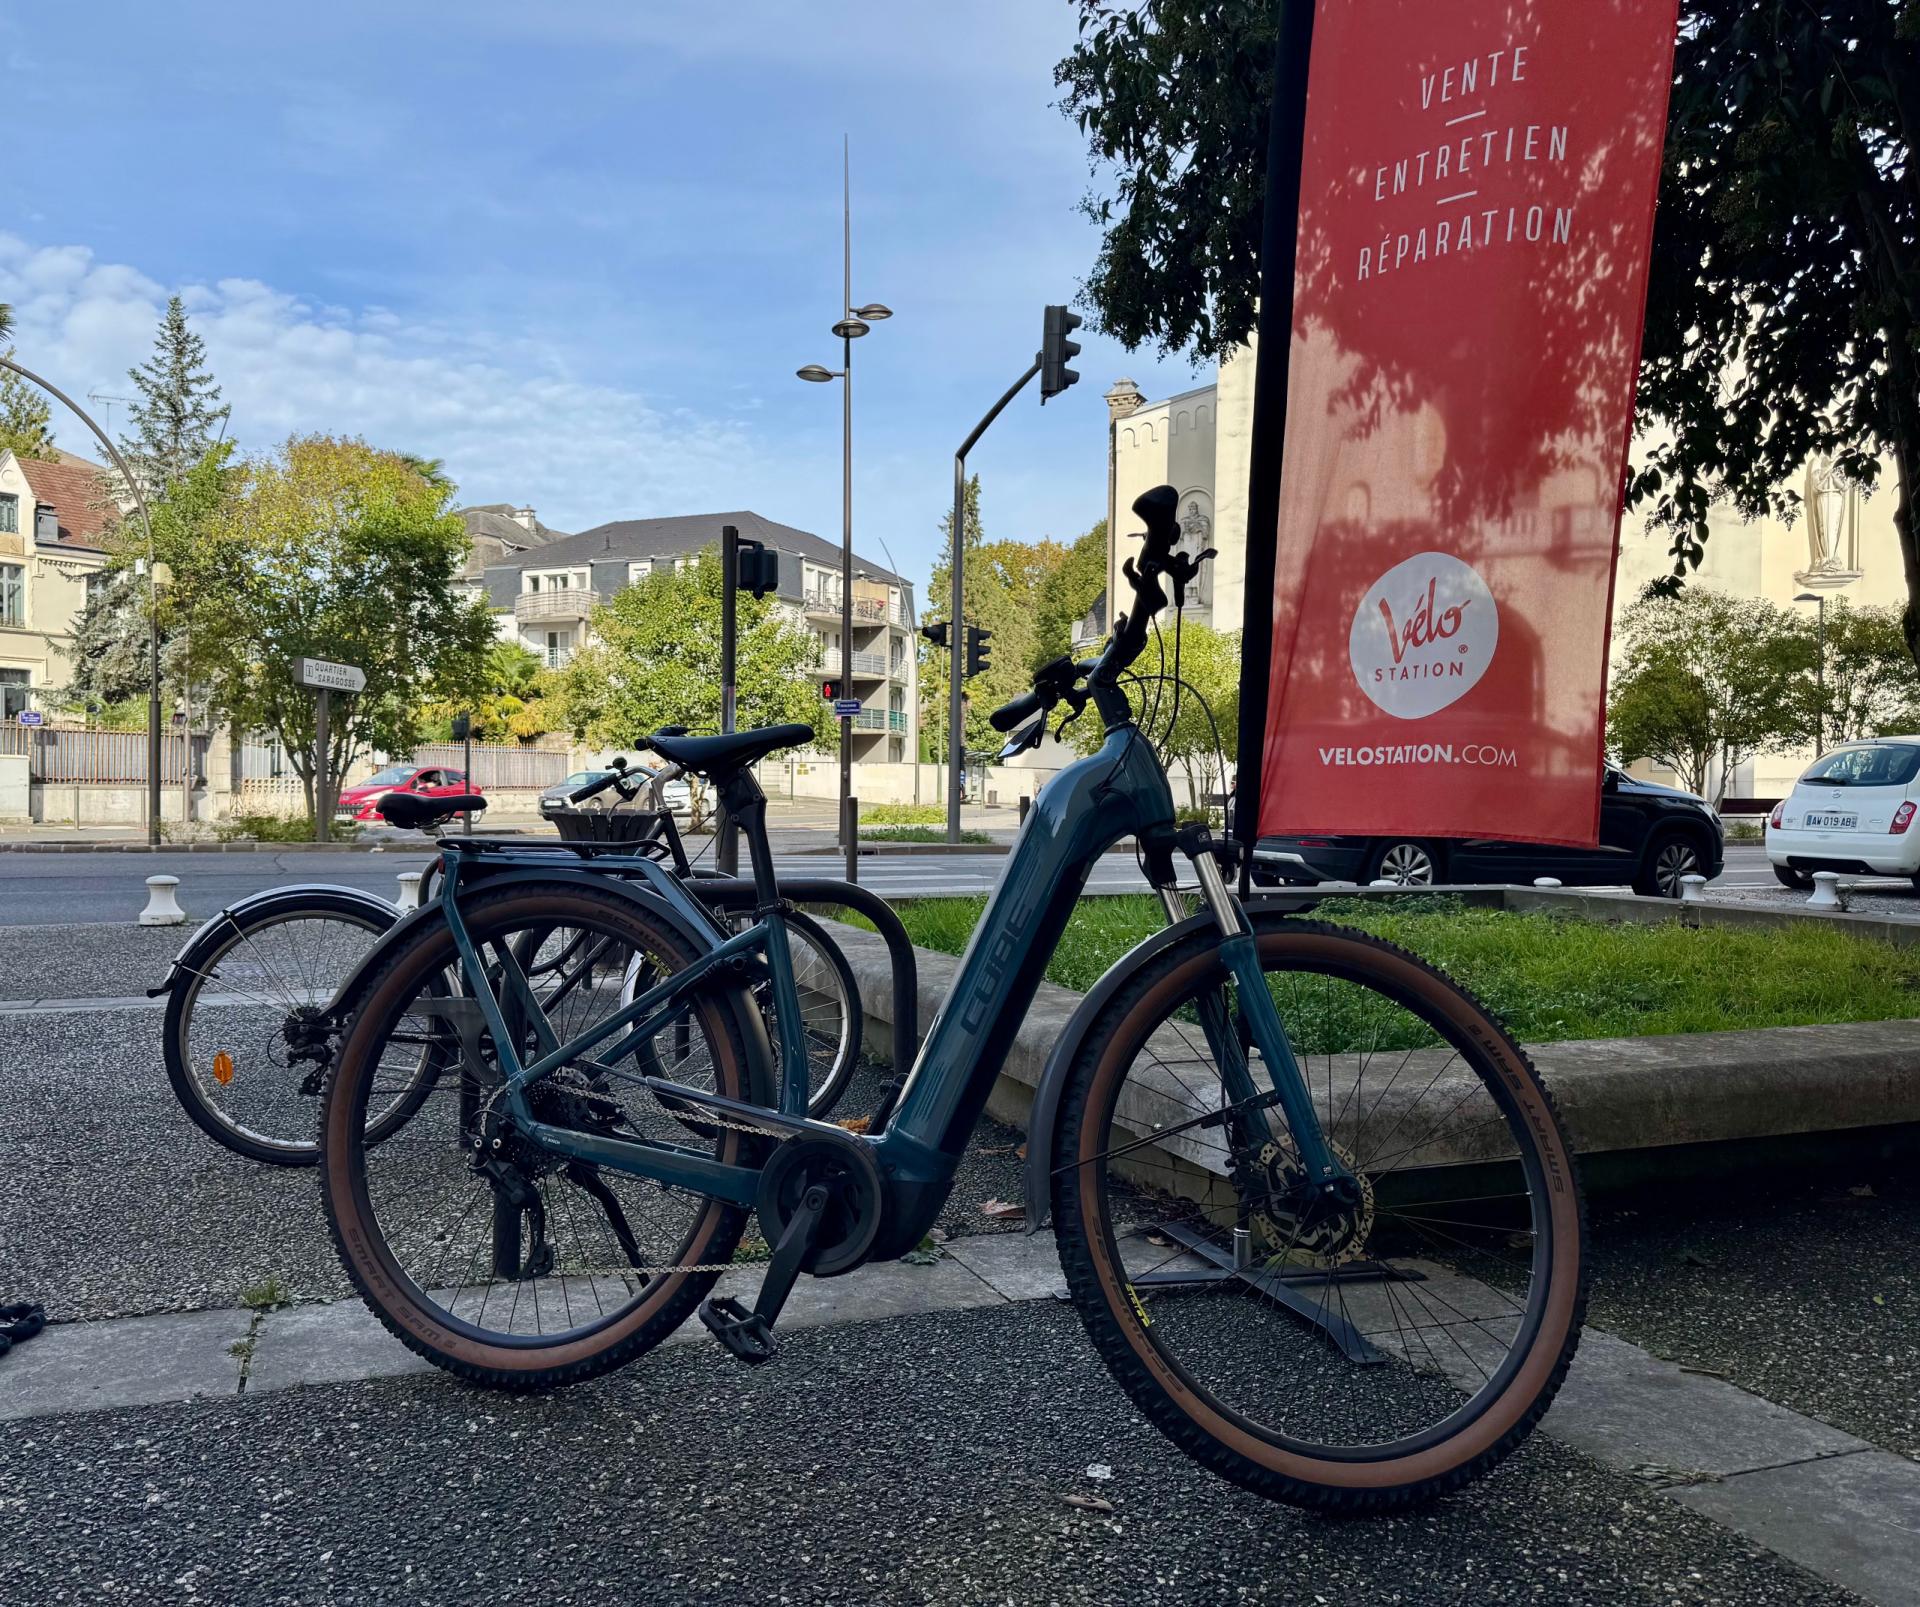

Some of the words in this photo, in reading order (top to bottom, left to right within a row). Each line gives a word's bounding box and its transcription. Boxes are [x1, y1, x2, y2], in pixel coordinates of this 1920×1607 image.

[1421, 46, 1528, 110] VENTE
[1374, 125, 1568, 201] ENTRETIEN
[1357, 205, 1572, 281] RÉPARATION
[1378, 576, 1471, 664] Vélo
[314, 662, 348, 676] QUARTIER
[317, 674, 356, 688] SARAGOSSE
[1375, 661, 1464, 682] STATION
[1318, 744, 1518, 767] VELOSTATION.COM
[960, 904, 1033, 1036] CUBE
[1482, 1039, 1524, 1091] SAM
[1523, 1100, 1565, 1194] SMART
[348, 1228, 396, 1299] SMART
